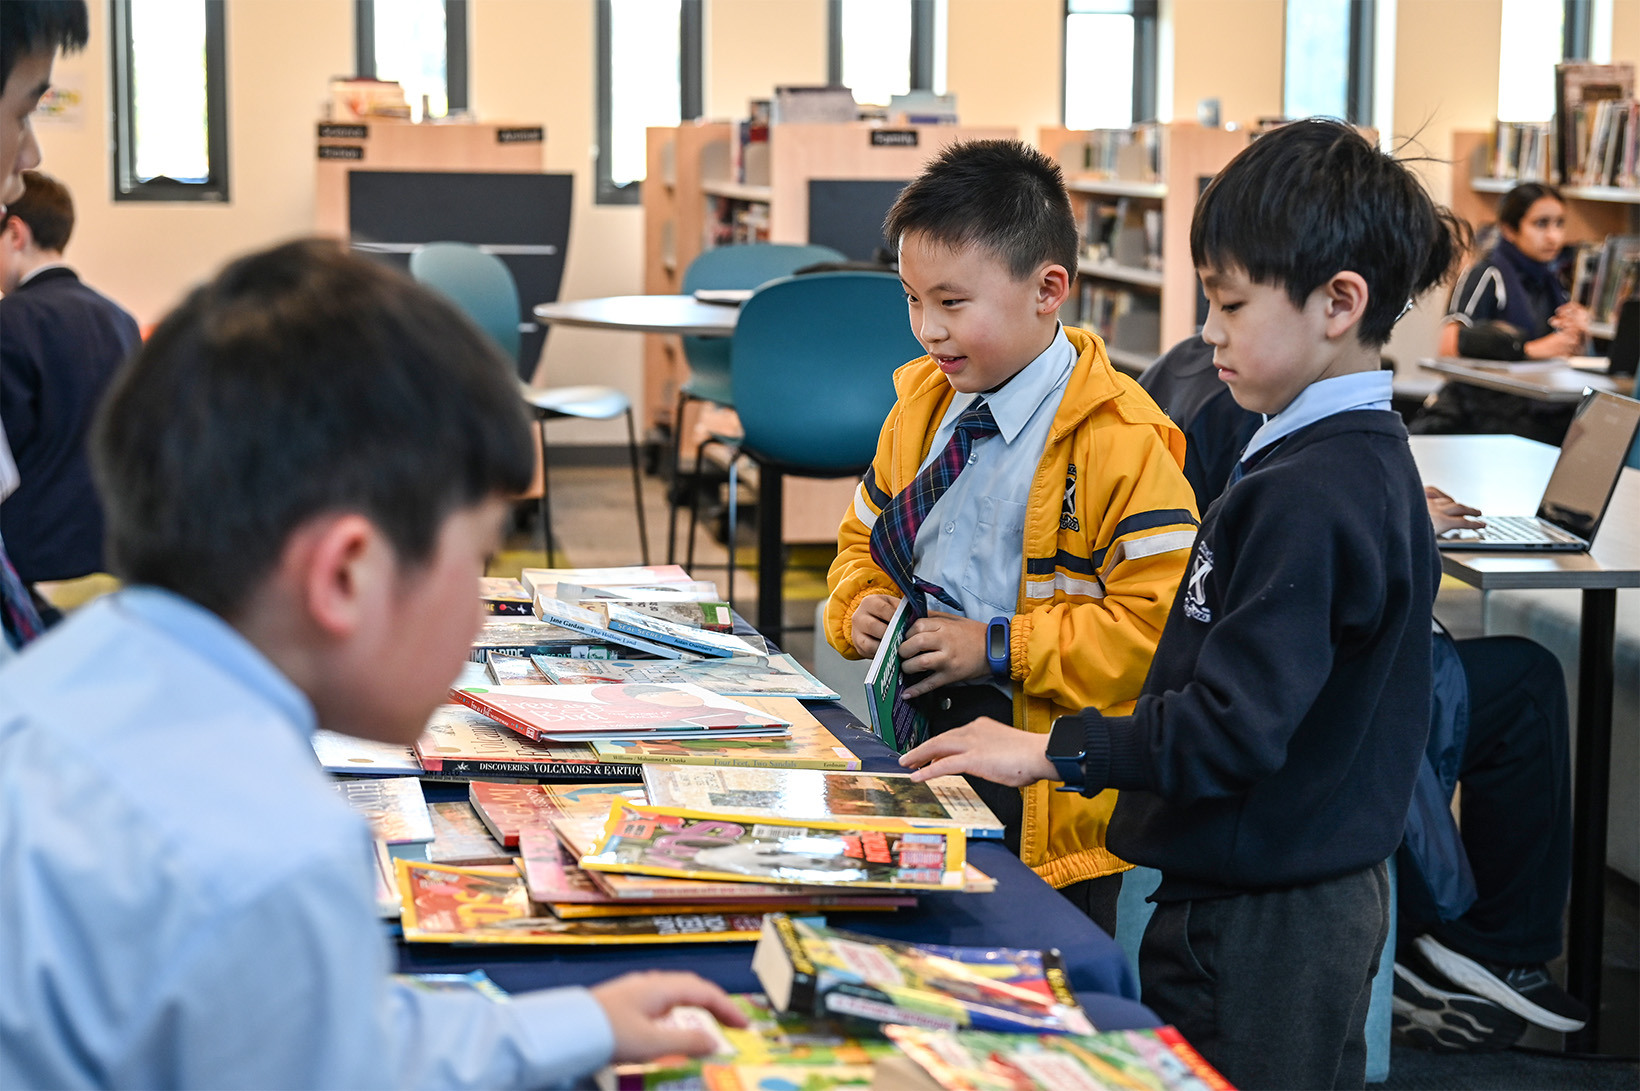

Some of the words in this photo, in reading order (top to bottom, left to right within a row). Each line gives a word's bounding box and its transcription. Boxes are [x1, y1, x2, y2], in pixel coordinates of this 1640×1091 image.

[549, 616, 563, 625] Jane
[563, 618, 585, 631] Gardam
[590, 628, 601, 636] The
[622, 638, 637, 646] Land
[617, 623, 635, 633] SEAL
[637, 628, 663, 640] SECRET
[674, 638, 688, 646] Aidan
[688, 640, 713, 652] Chambers
[479, 763, 530, 772] DISCOVERIES
[533, 764, 592, 775] VOLCANOES
[593, 765, 602, 775] &
[713, 758, 730, 766] Four
[753, 759, 768, 767] Two
[769, 760, 797, 768] Sandals
